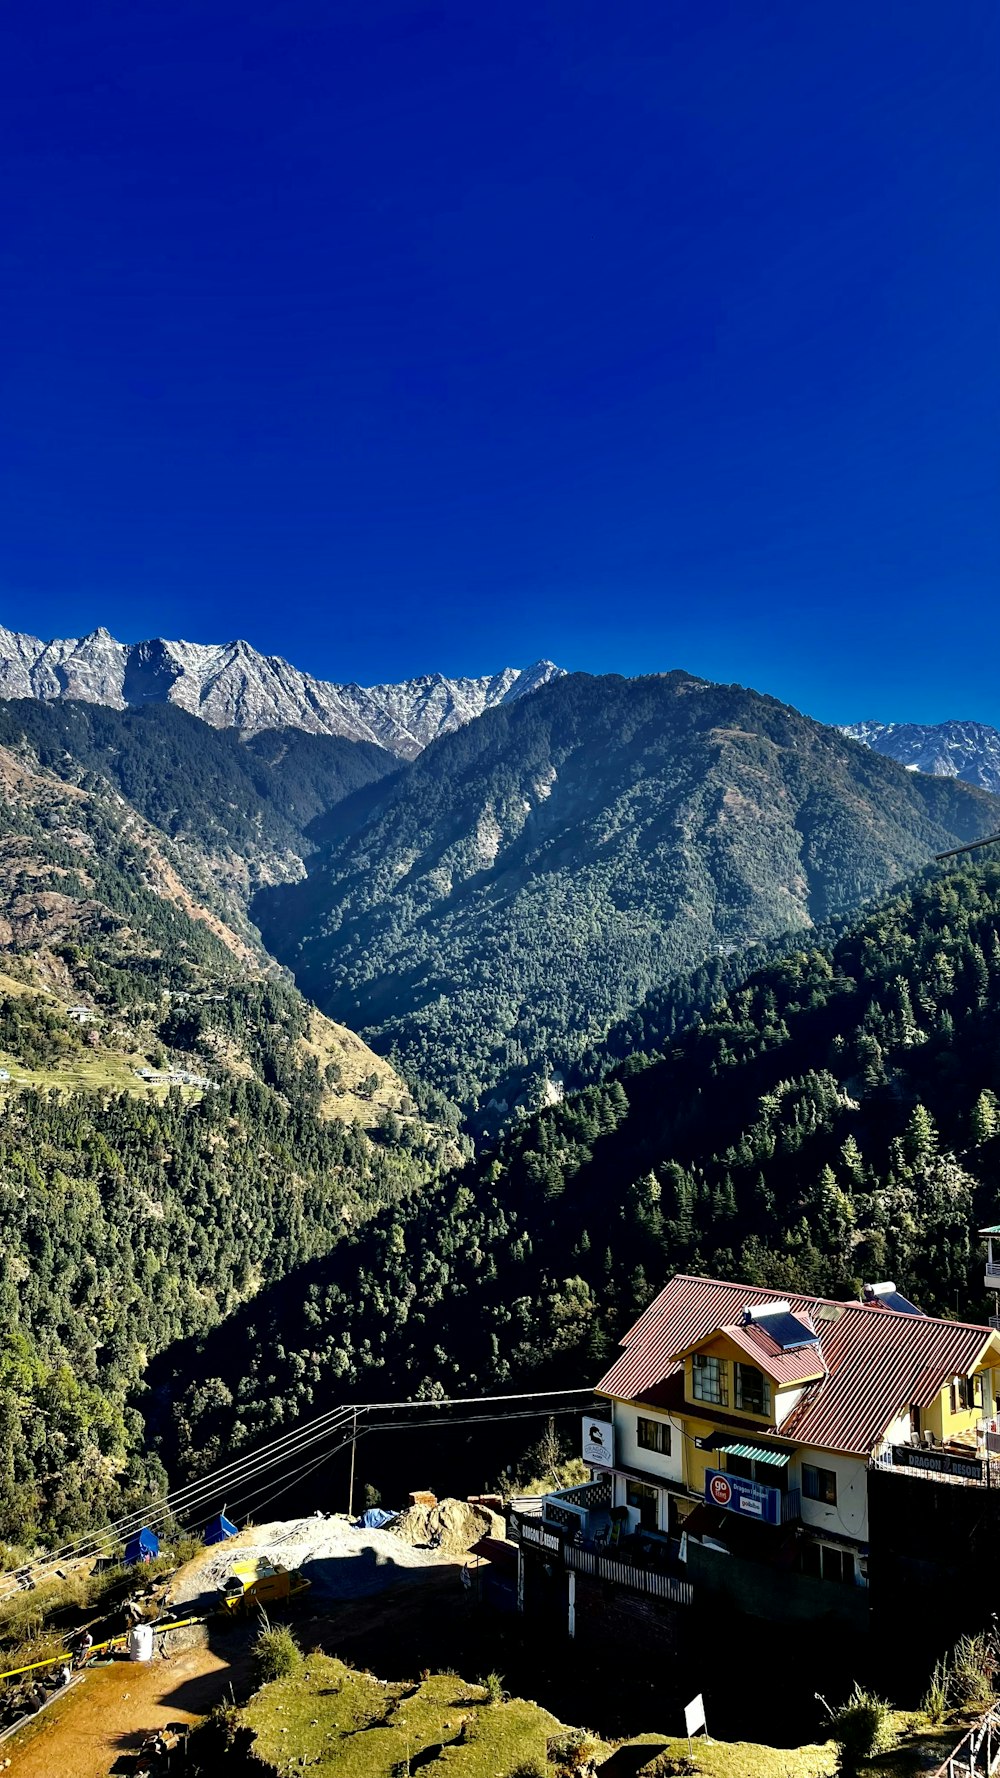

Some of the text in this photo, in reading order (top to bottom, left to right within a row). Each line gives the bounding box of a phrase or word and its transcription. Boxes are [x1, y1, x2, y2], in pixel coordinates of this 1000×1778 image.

[585, 1446, 608, 1457] DRAGON
[909, 1454, 942, 1471] DRAGON
[952, 1463, 981, 1478] RESORT
[714, 1480, 727, 1491] go
[733, 1483, 750, 1494] Dragon
[522, 1524, 540, 1543] DRAGON
[544, 1534, 560, 1551] RESORT
